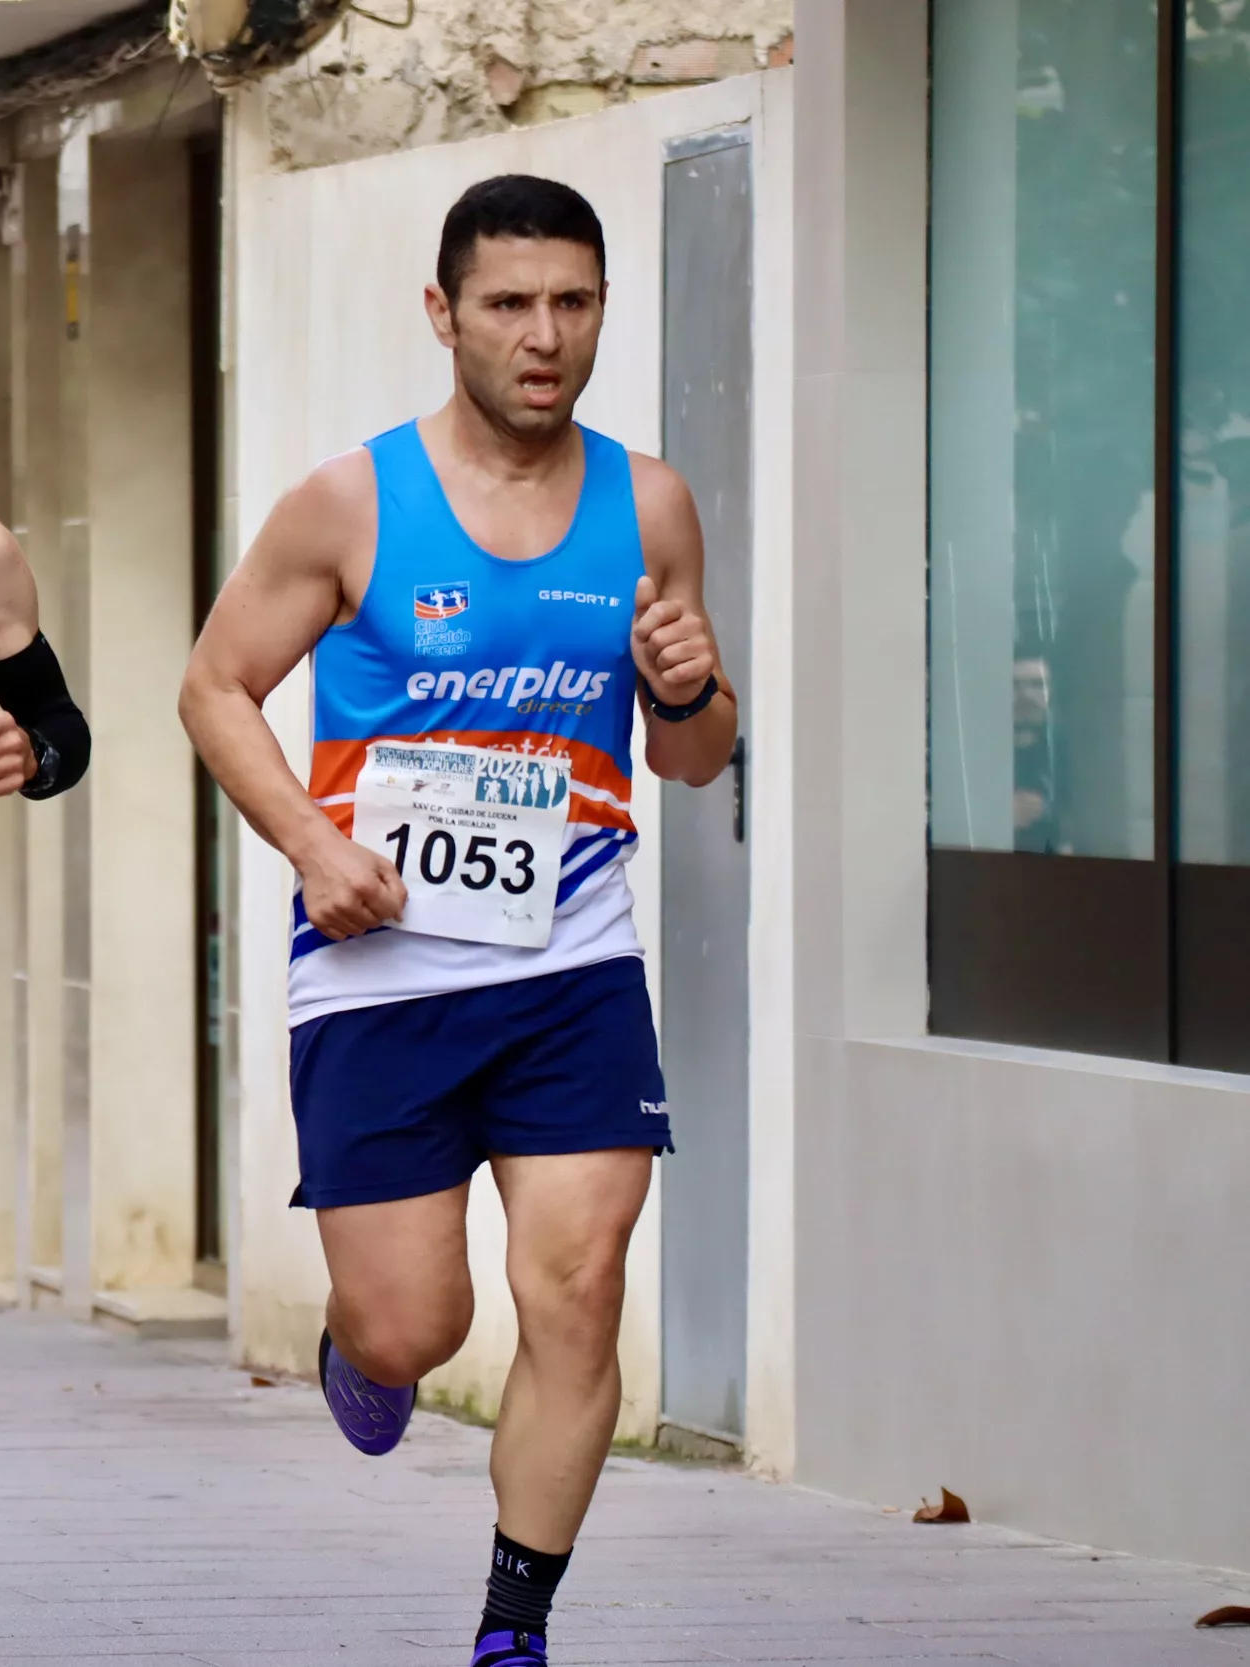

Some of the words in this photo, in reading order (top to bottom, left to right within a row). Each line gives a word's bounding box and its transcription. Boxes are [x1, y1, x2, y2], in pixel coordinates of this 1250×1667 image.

[538, 589, 606, 606] GSPORT
[414, 620, 448, 633] Club
[406, 660, 611, 708] enerplus
[413, 750, 462, 763] PROVINCIAL
[422, 760, 475, 776] POPULARES
[477, 753, 528, 779] 2024
[428, 815, 443, 824] POR
[445, 817, 455, 826] LA
[447, 806, 474, 816] CIUDAD
[476, 810, 486, 818] DE
[487, 811, 517, 821] LUCENA
[385, 823, 535, 895] 1053
